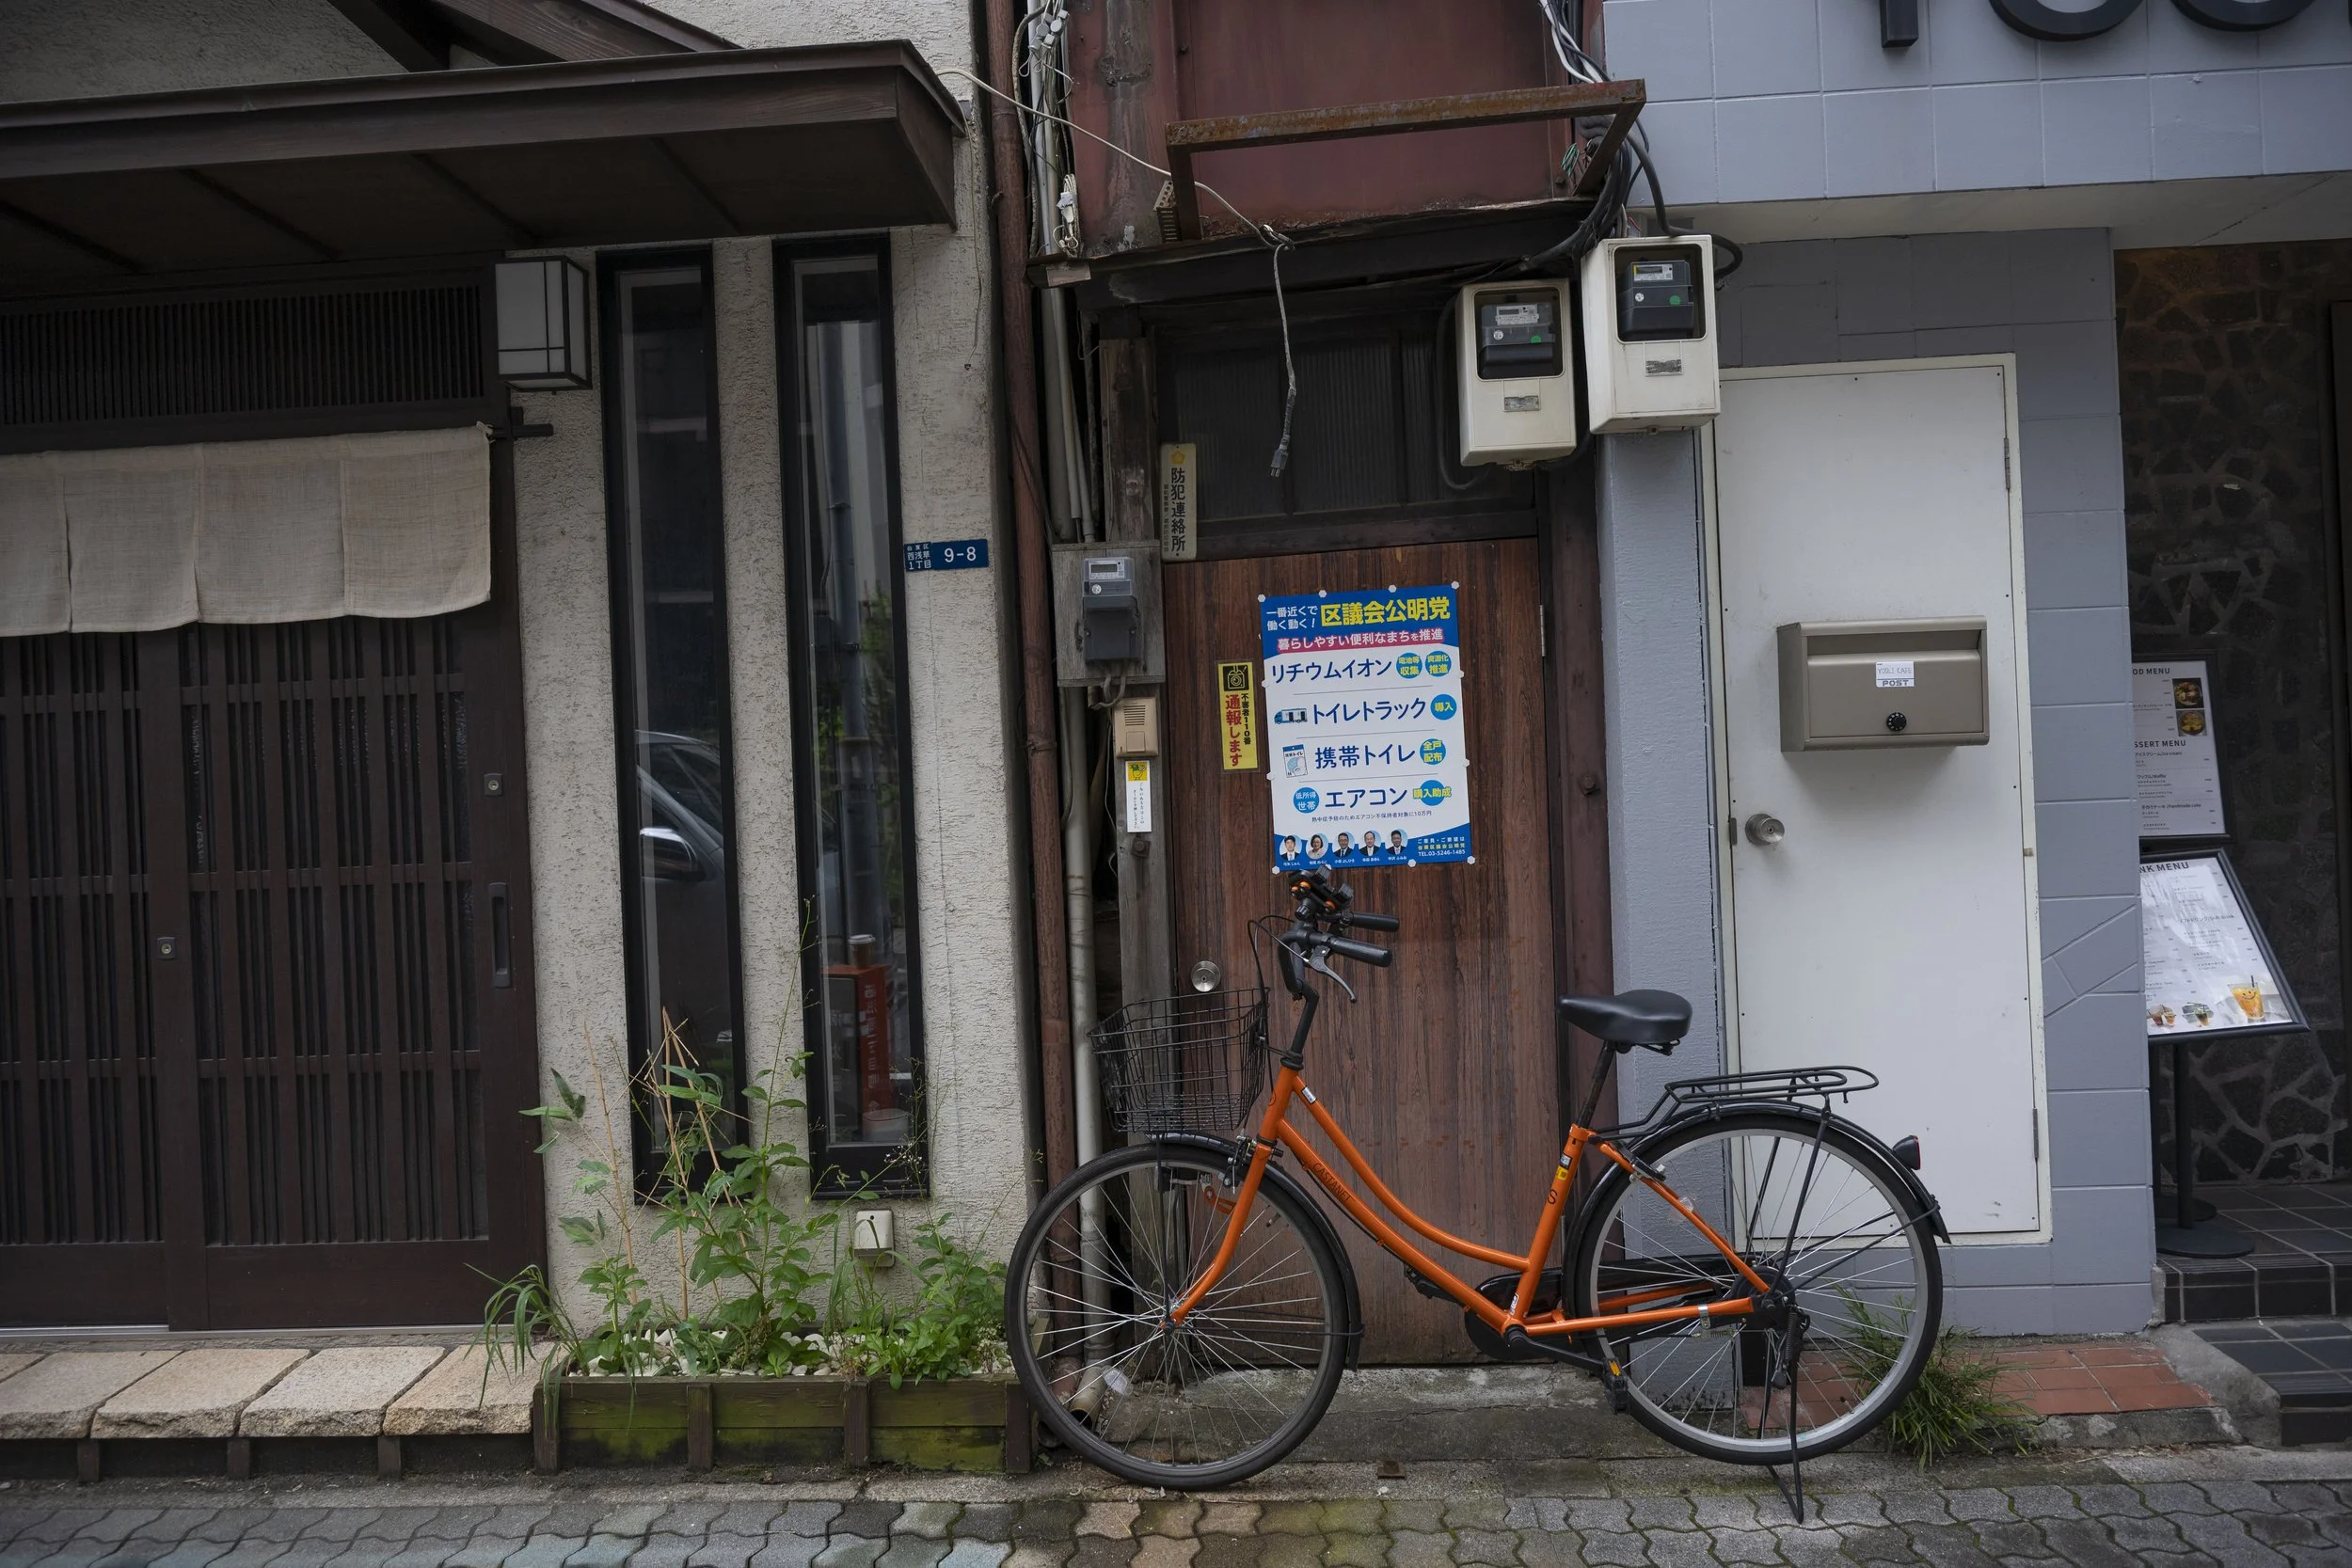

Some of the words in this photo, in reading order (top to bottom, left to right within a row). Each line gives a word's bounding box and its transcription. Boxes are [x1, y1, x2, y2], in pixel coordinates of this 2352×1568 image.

[1170, 467, 1185, 552] 防犯連絡所
[907, 550, 930, 561] 西浅草
[909, 560, 931, 570] 1丁目
[944, 546, 977, 562] 9-8
[1265, 605, 1318, 618] 一番近くで
[1320, 596, 1451, 626] 区議会公明党
[1278, 628, 1444, 651] 暮らしやすい便利なまちを推進
[1271, 658, 1392, 684] リチウムイオン
[1312, 697, 1426, 725] トイレトラック
[1225, 694, 1243, 767] 通報します
[2134, 740, 2160, 749] SSERT
[2162, 739, 2186, 748] MENU
[1314, 743, 1415, 769] 携帯トイレ
[1325, 786, 1407, 808] エアコン
[1412, 787, 1453, 800] 購入助成
[1297, 800, 1316, 811] 世帯
[2139, 864, 2154, 874] NK
[2156, 862, 2189, 872] MENU
[1312, 1163, 1356, 1203] CASTANET
